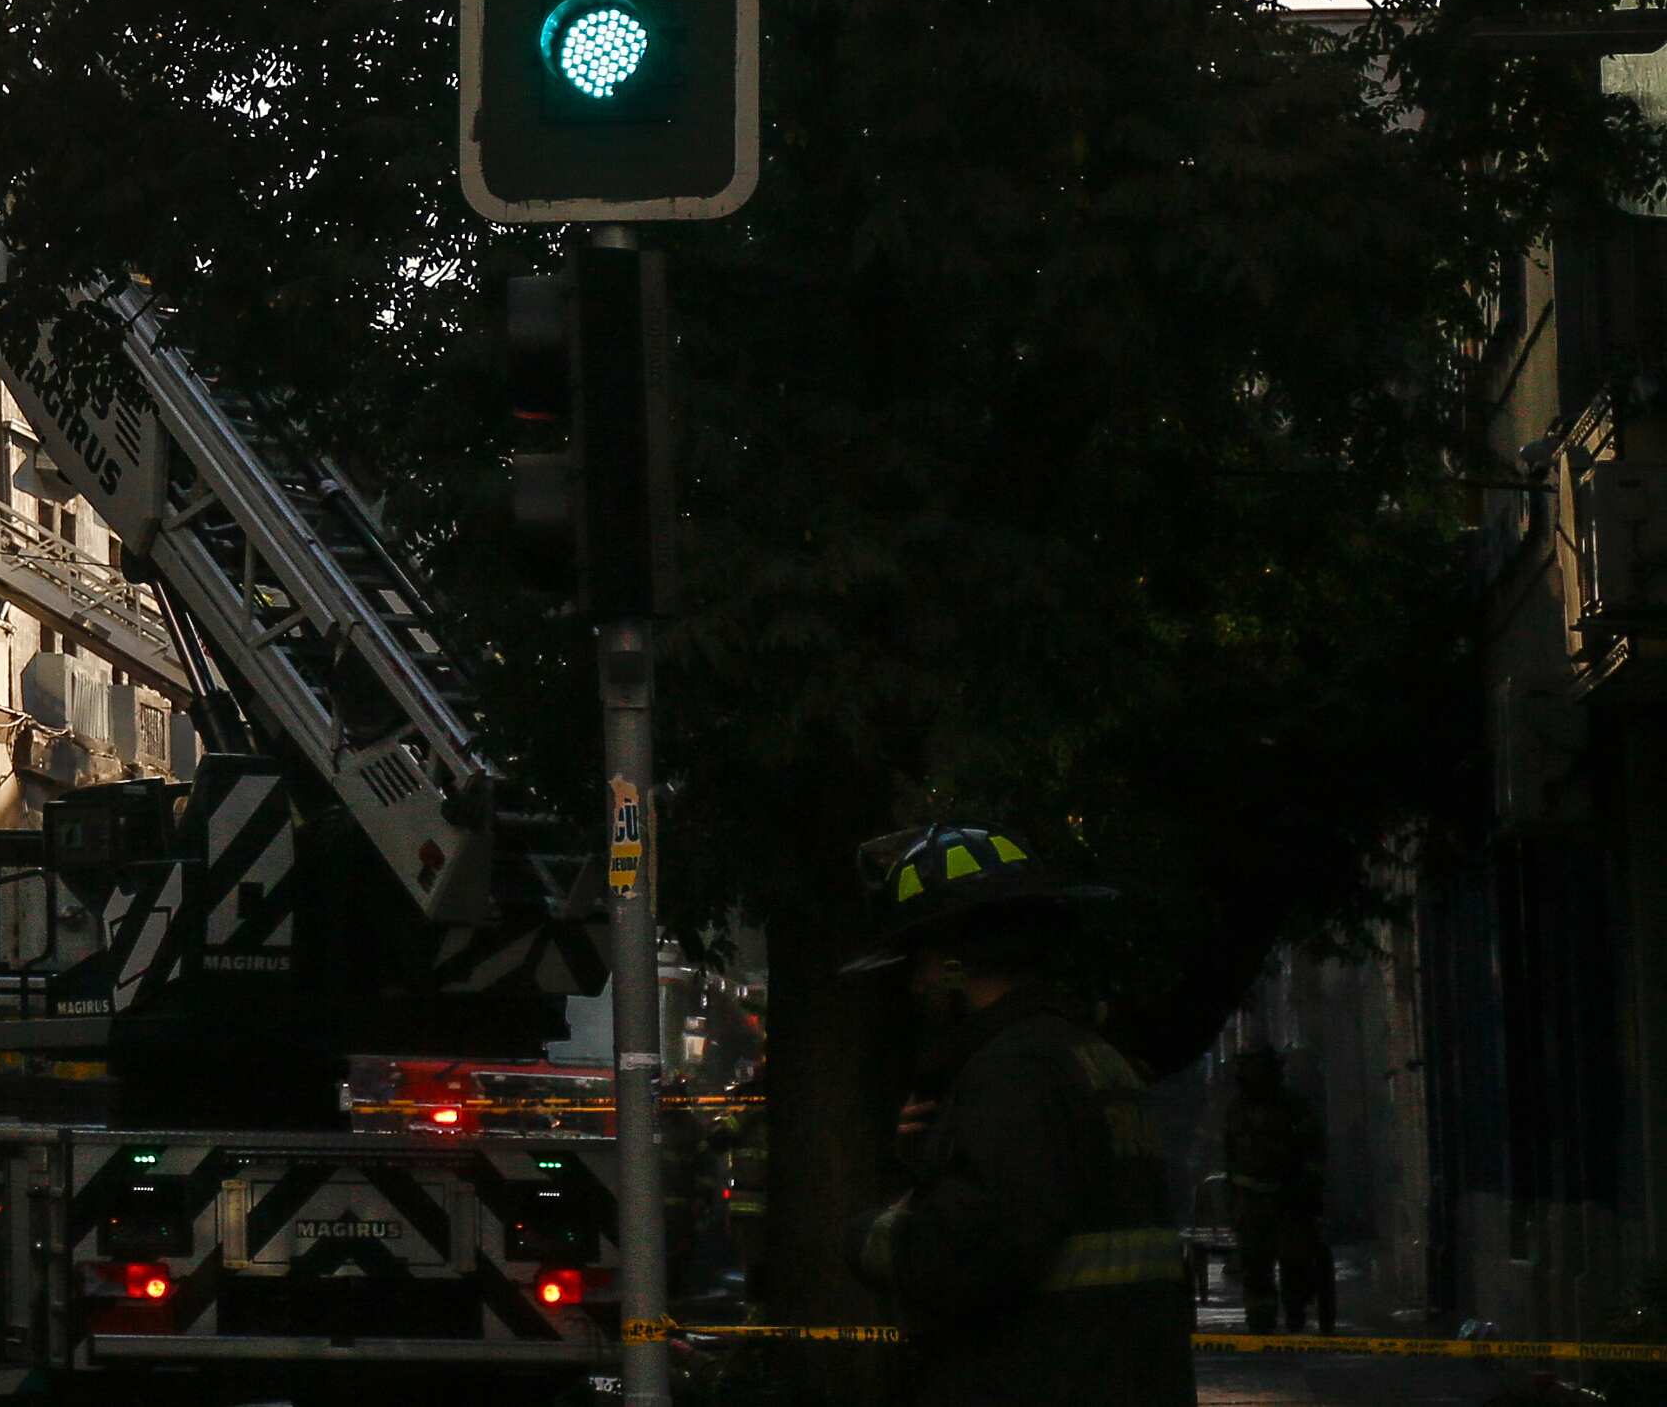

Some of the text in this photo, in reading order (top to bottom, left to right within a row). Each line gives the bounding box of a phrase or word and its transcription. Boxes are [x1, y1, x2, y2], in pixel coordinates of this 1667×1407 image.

[14, 346, 122, 495] AGIRUS
[202, 954, 291, 971] MAGIRUS
[57, 999, 110, 1015] MAGIRUS
[296, 1220, 402, 1239] MAGIRUS
